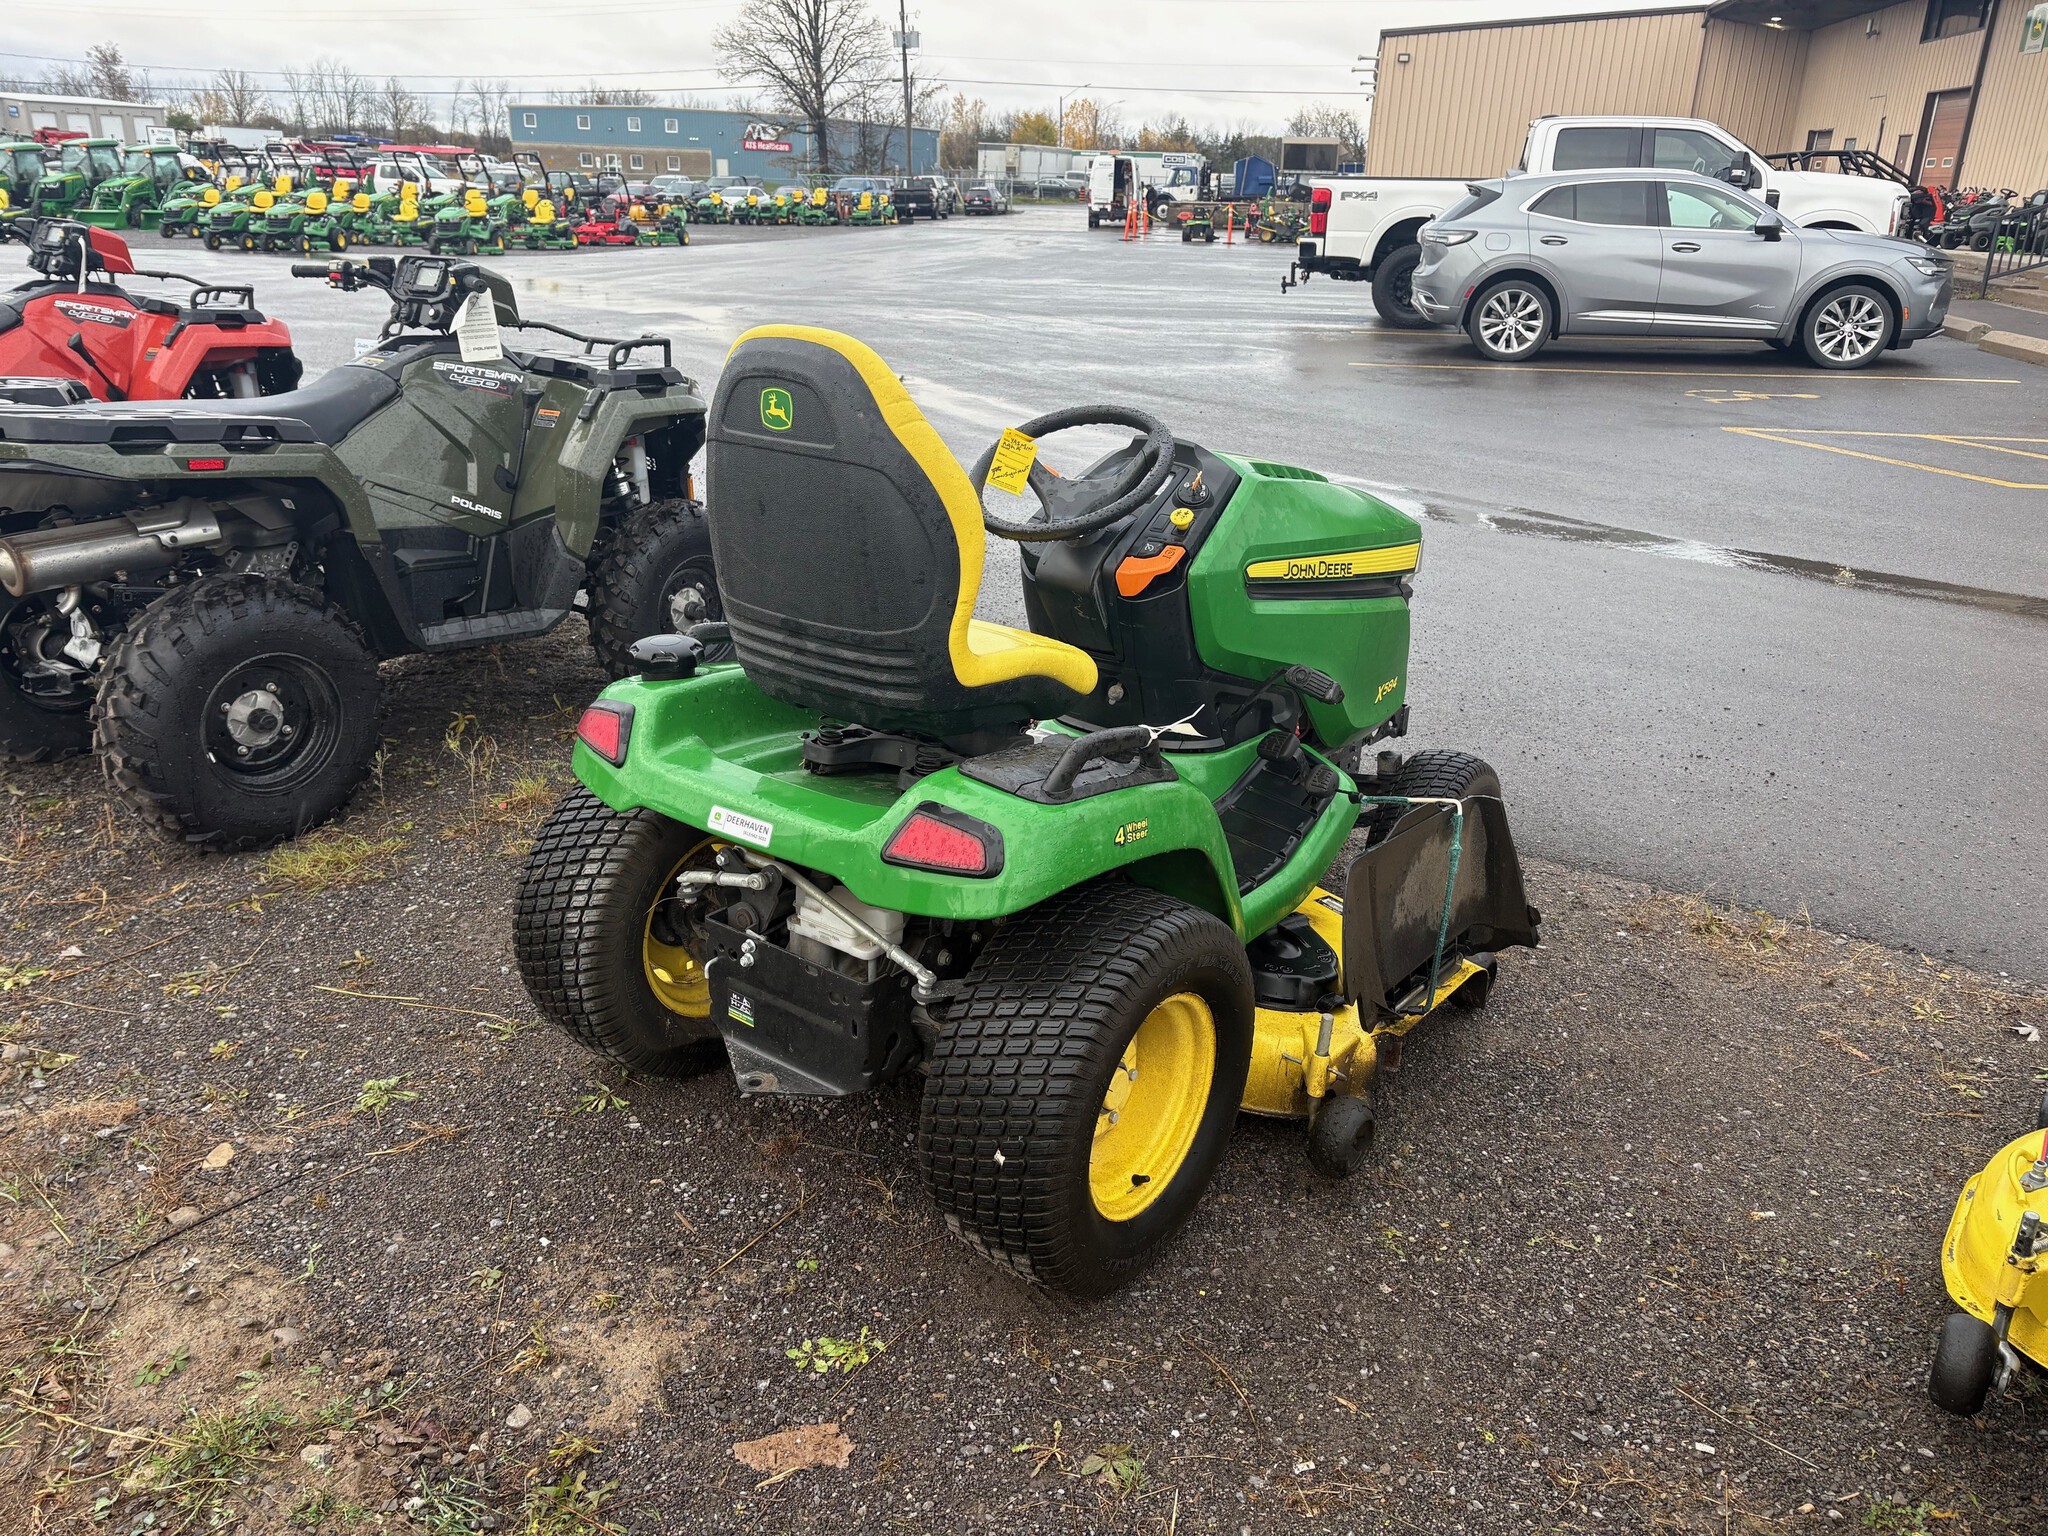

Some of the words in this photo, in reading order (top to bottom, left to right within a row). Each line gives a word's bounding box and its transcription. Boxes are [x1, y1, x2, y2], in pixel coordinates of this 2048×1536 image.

[745, 141, 757, 150] ATS
[757, 142, 790, 151] Healthcare
[1340, 191, 1378, 201] FX4
[54, 300, 137, 320] SPORTSMAN
[68, 309, 115, 324] 450
[432, 361, 524, 384] SPORTSMAN
[449, 373, 500, 390] 450
[451, 495, 503, 520] POLARIS
[1283, 561, 1317, 579] JOHN
[1317, 560, 1354, 578] DEERE
[1374, 676, 1399, 704] X584
[726, 814, 770, 835] DEERHAVEN
[1114, 825, 1126, 846] 4
[1125, 817, 1149, 832] Wheel
[1126, 829, 1149, 843] Steer
